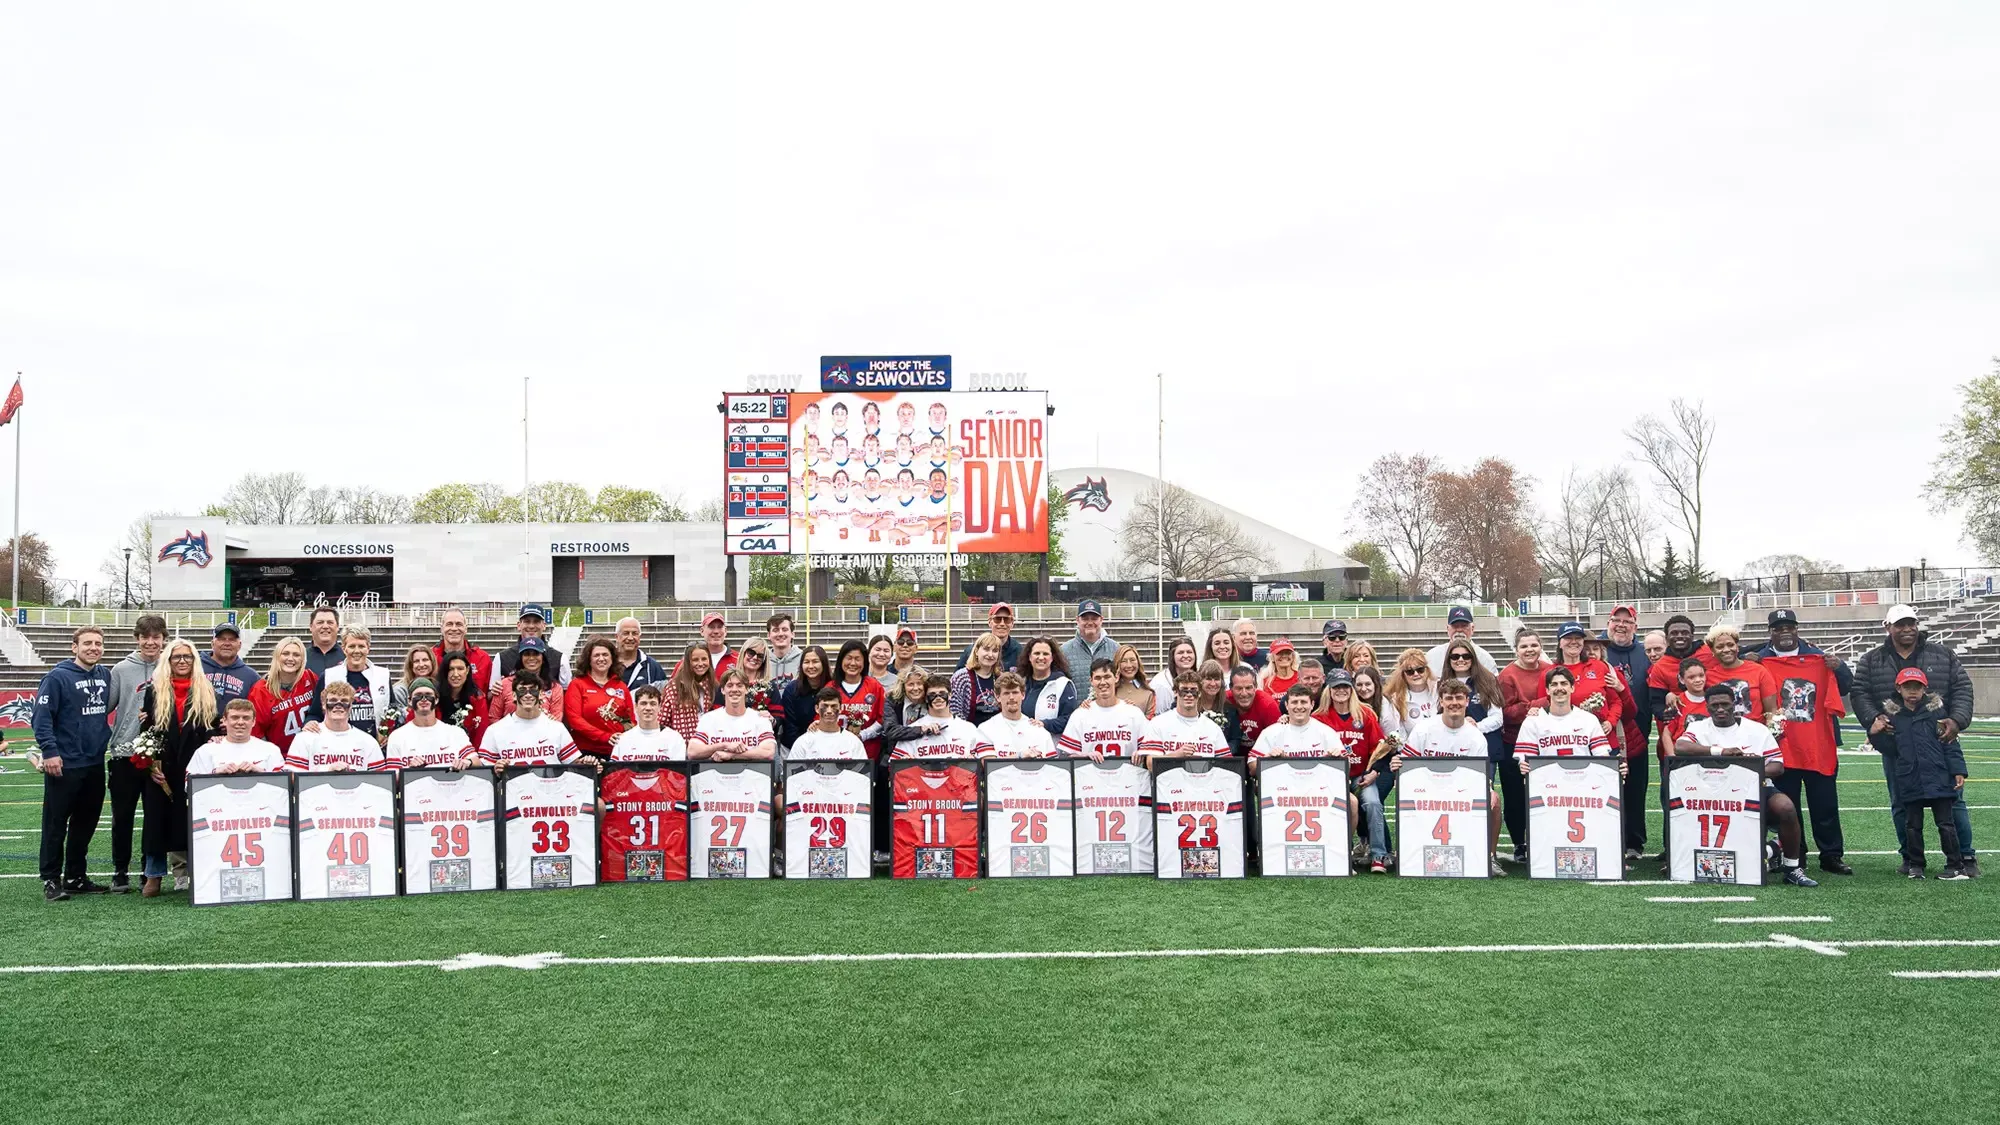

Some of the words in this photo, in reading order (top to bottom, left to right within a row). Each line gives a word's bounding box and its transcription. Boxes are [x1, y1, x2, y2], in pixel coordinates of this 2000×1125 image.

[870, 361, 898, 370] HOME
[899, 361, 912, 370] OF
[913, 361, 932, 370] THE
[747, 374, 802, 393] STONY
[856, 371, 945, 387] SEAWOLVES
[969, 373, 1027, 391] BROOK
[731, 402, 767, 413] 45:22
[763, 425, 769, 434] 0
[960, 419, 1043, 458] SENIOR
[734, 443, 740, 451] 2
[763, 475, 769, 483] 0
[734, 493, 740, 501] 2
[964, 461, 1043, 534] DAY
[303, 544, 395, 555] CONCESSIONS
[551, 542, 630, 553] RESTROOMS
[740, 538, 777, 550] CAA
[846, 555, 886, 568] FAMILY
[892, 554, 969, 568] SCOREBOARD
[1084, 730, 1132, 743] SEAWOLVES
[1539, 735, 1589, 748] SEAWOLVES
[502, 746, 555, 760] SEAWOLVES
[917, 744, 965, 757] SEAWOLVES
[1164, 741, 1213, 754] SEAWLVES
[616, 801, 642, 812] STONY
[645, 800, 672, 811] BROOK
[703, 801, 755, 813] SEAWOLVES
[802, 803, 854, 814] SEAWOLVES
[907, 799, 932, 810] STONY
[935, 799, 961, 810] BROOK
[1003, 798, 1055, 810] SEAWOLVES
[1084, 796, 1136, 808] SEAWOLVES
[1172, 800, 1224, 812] SEAWOLVES
[1277, 796, 1329, 808] SEAWOLVES
[1416, 799, 1471, 812] SEAWOLVES
[1547, 796, 1603, 809] SEAWOLVES
[1686, 799, 1742, 812] SEAWOLVES
[422, 810, 478, 823] SEAWOLVES
[522, 805, 577, 819] SEAWOLVES
[212, 816, 272, 832] SEAWOLVES
[318, 817, 376, 830] SEAWOLVES
[920, 813, 946, 844] 11
[1011, 811, 1047, 843] 26
[1095, 810, 1126, 841] 12
[1285, 810, 1322, 842] 25
[1431, 814, 1451, 845] 4
[1567, 810, 1585, 843] 5
[532, 820, 570, 853] 33
[630, 815, 660, 846] 31
[710, 815, 747, 846] 27
[810, 816, 846, 848] 29
[1178, 814, 1219, 848] 23
[1698, 814, 1730, 848] 17
[431, 824, 470, 858] 39
[220, 832, 265, 867] 45
[327, 832, 369, 865] 40
